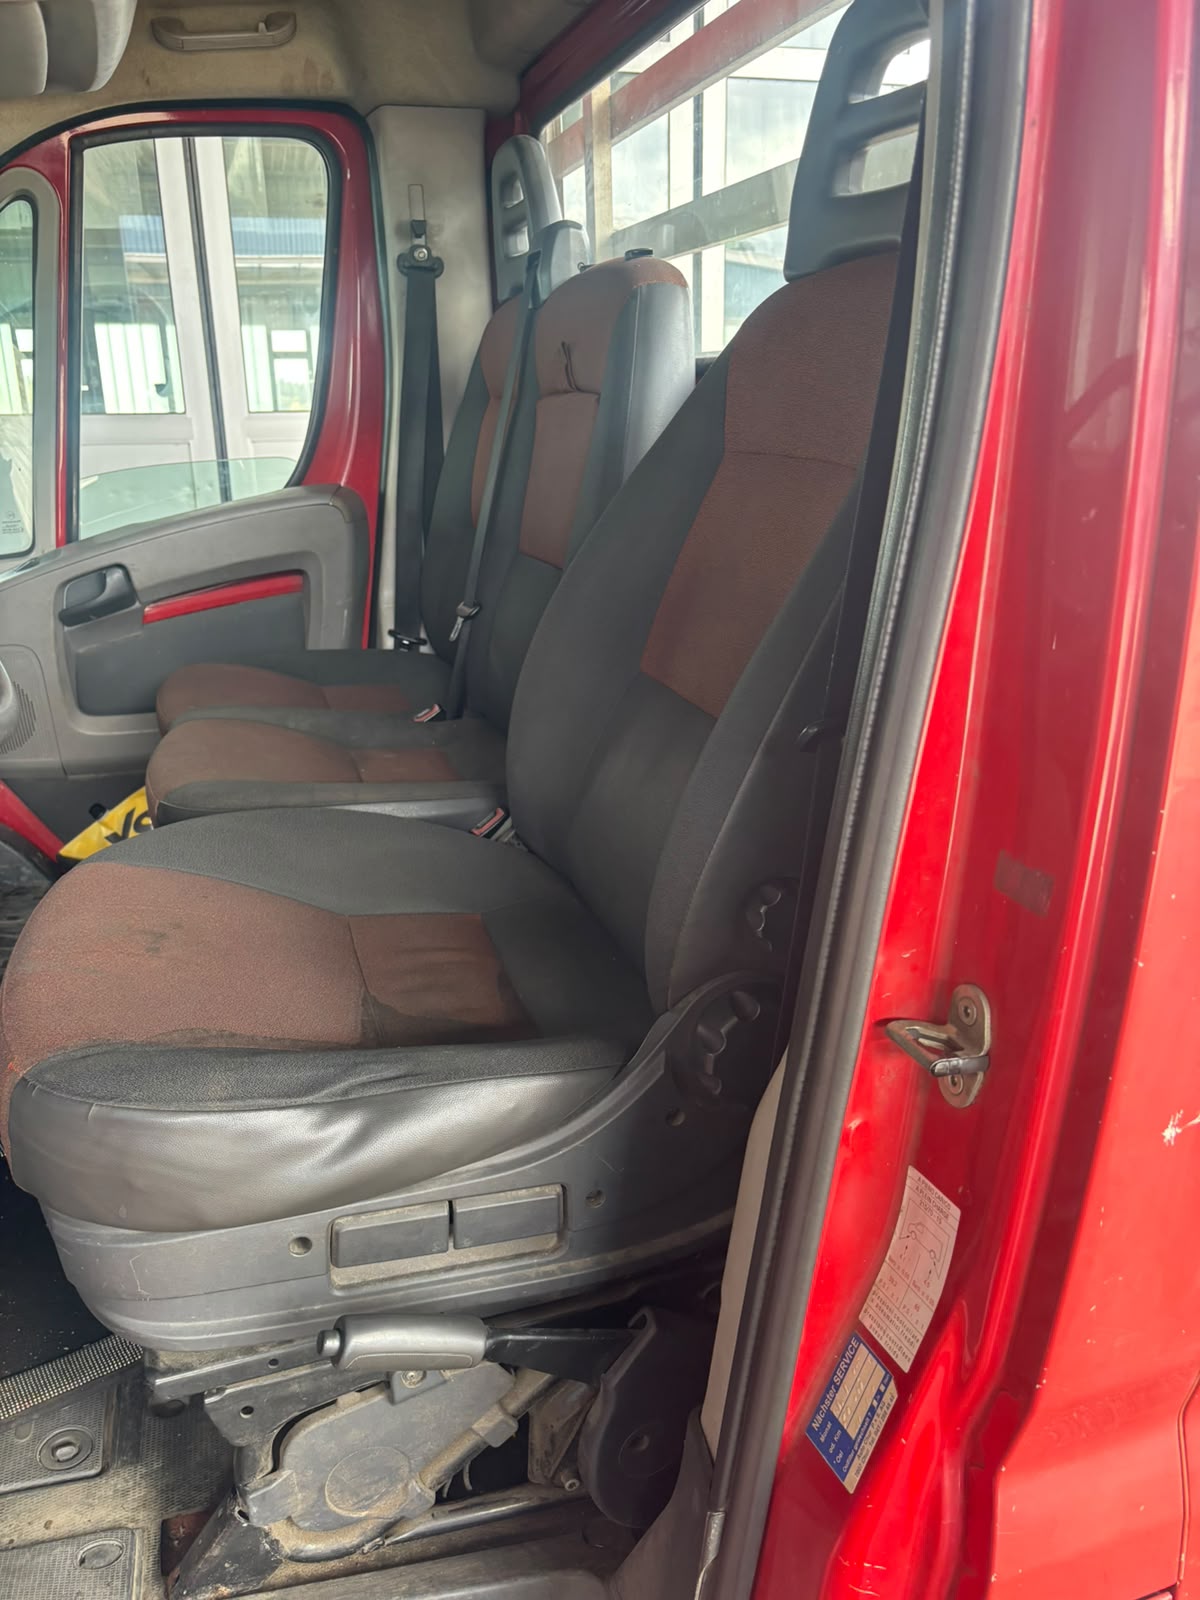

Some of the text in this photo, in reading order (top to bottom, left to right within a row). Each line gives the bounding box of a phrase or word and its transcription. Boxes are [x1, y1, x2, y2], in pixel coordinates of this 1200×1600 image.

[811, 1335, 859, 1432] Nächster SERVICE
[819, 1419, 832, 1444] Monat
[833, 1427, 841, 1442] Km
